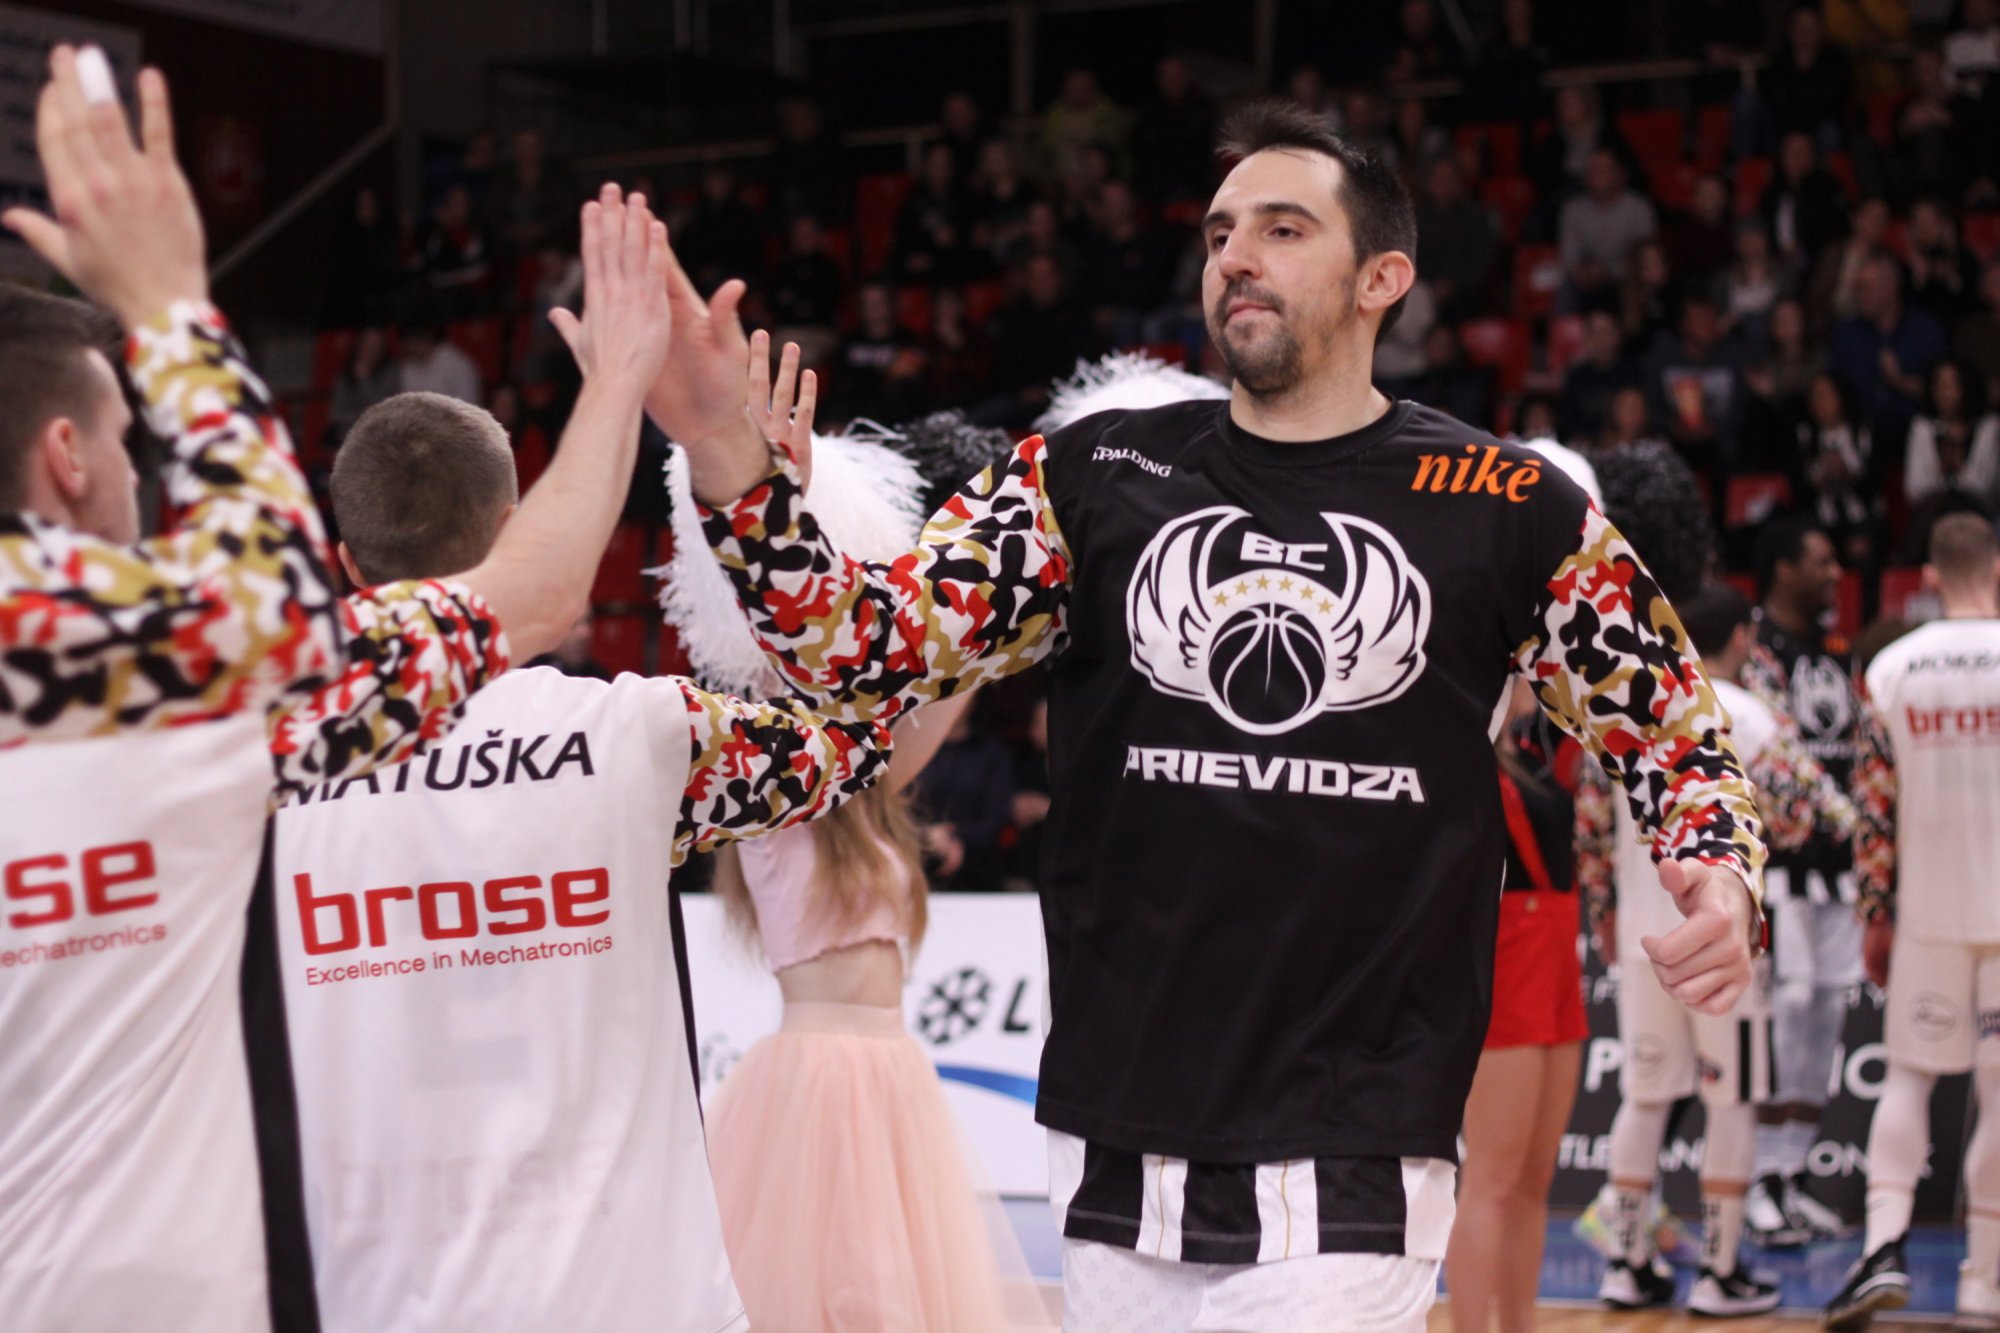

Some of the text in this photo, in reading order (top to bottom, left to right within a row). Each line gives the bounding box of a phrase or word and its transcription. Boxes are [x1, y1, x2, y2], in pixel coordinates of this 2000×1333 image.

[1240, 532, 1329, 572] BC
[1123, 745, 1426, 803] PRIEVIDZA
[294, 867, 610, 956] brose
[306, 934, 614, 986] Excellence in Mechatronics
